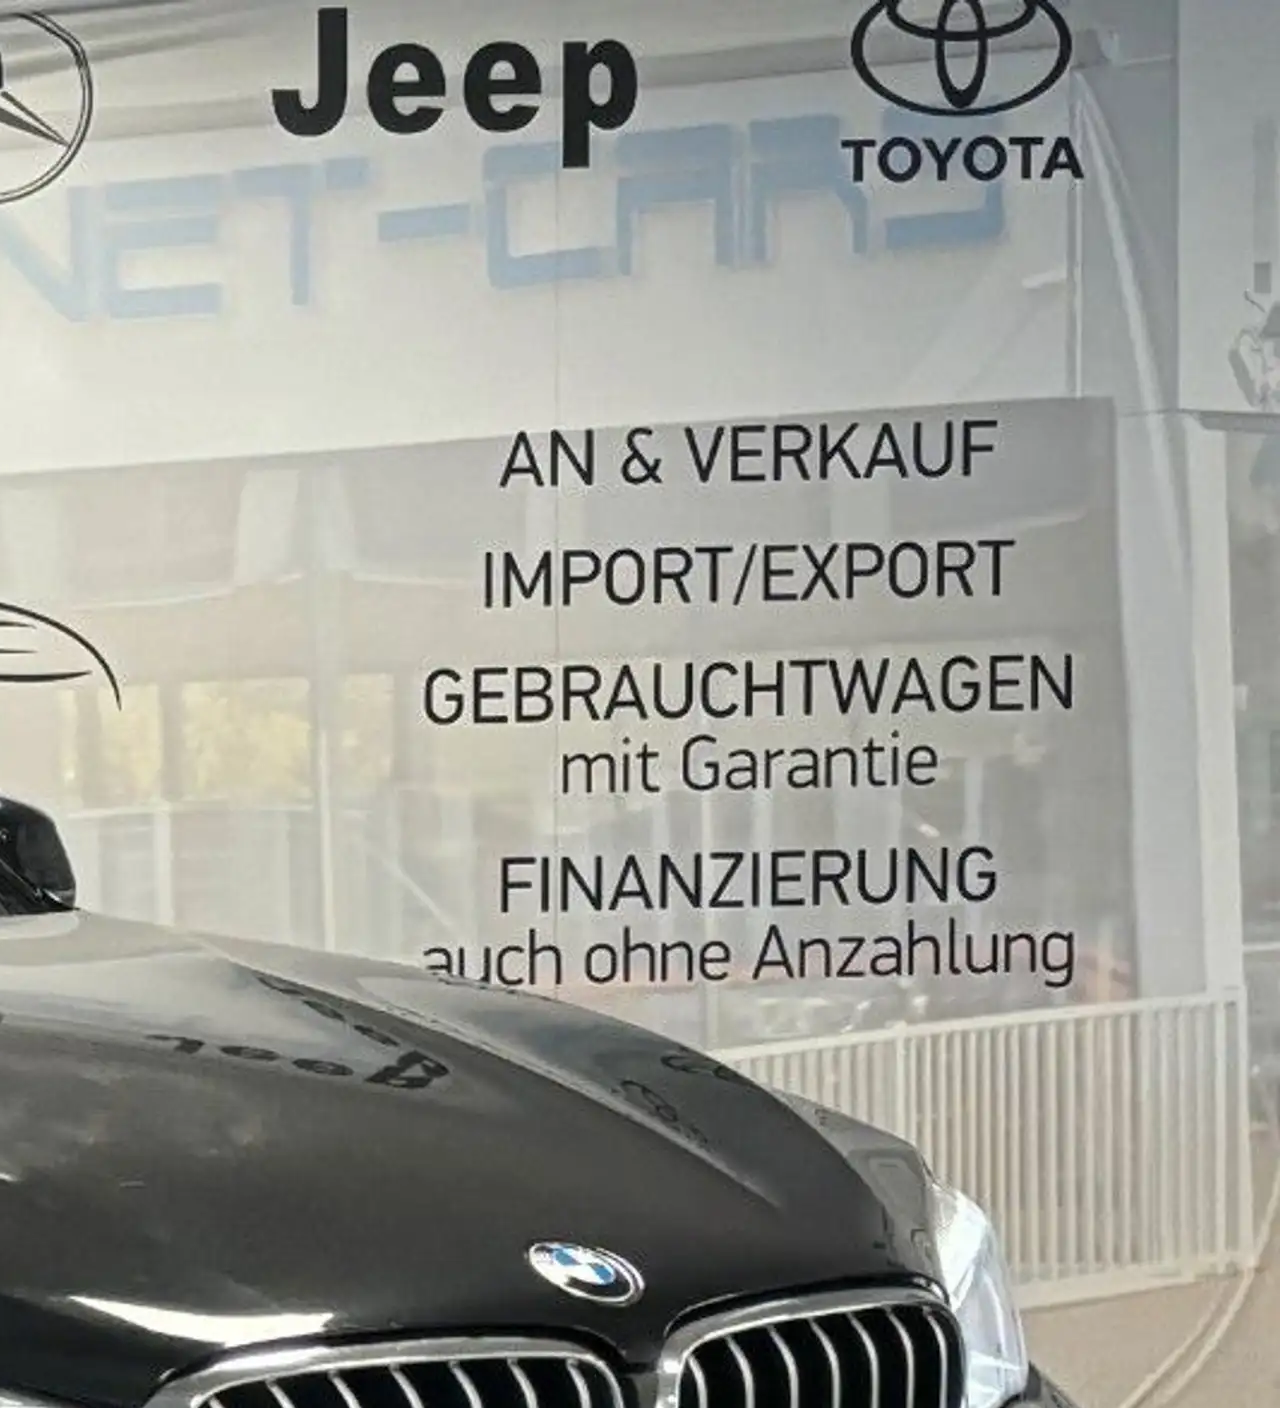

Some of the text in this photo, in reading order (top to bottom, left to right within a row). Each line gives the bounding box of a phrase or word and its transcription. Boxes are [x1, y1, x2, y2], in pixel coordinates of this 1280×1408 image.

[272, 6, 638, 169] Jeep
[840, 135, 1085, 183] TOYOTA
[500, 419, 998, 488] AN & VERKAUF
[484, 540, 1016, 608] IMPORT/EXPORT
[423, 653, 1073, 725] GEBRAUCHTWAGEN
[562, 732, 939, 794] mit Garantie
[501, 846, 997, 913] FINANZIERUNG
[423, 917, 1074, 988] auch ohne Anzahlung
